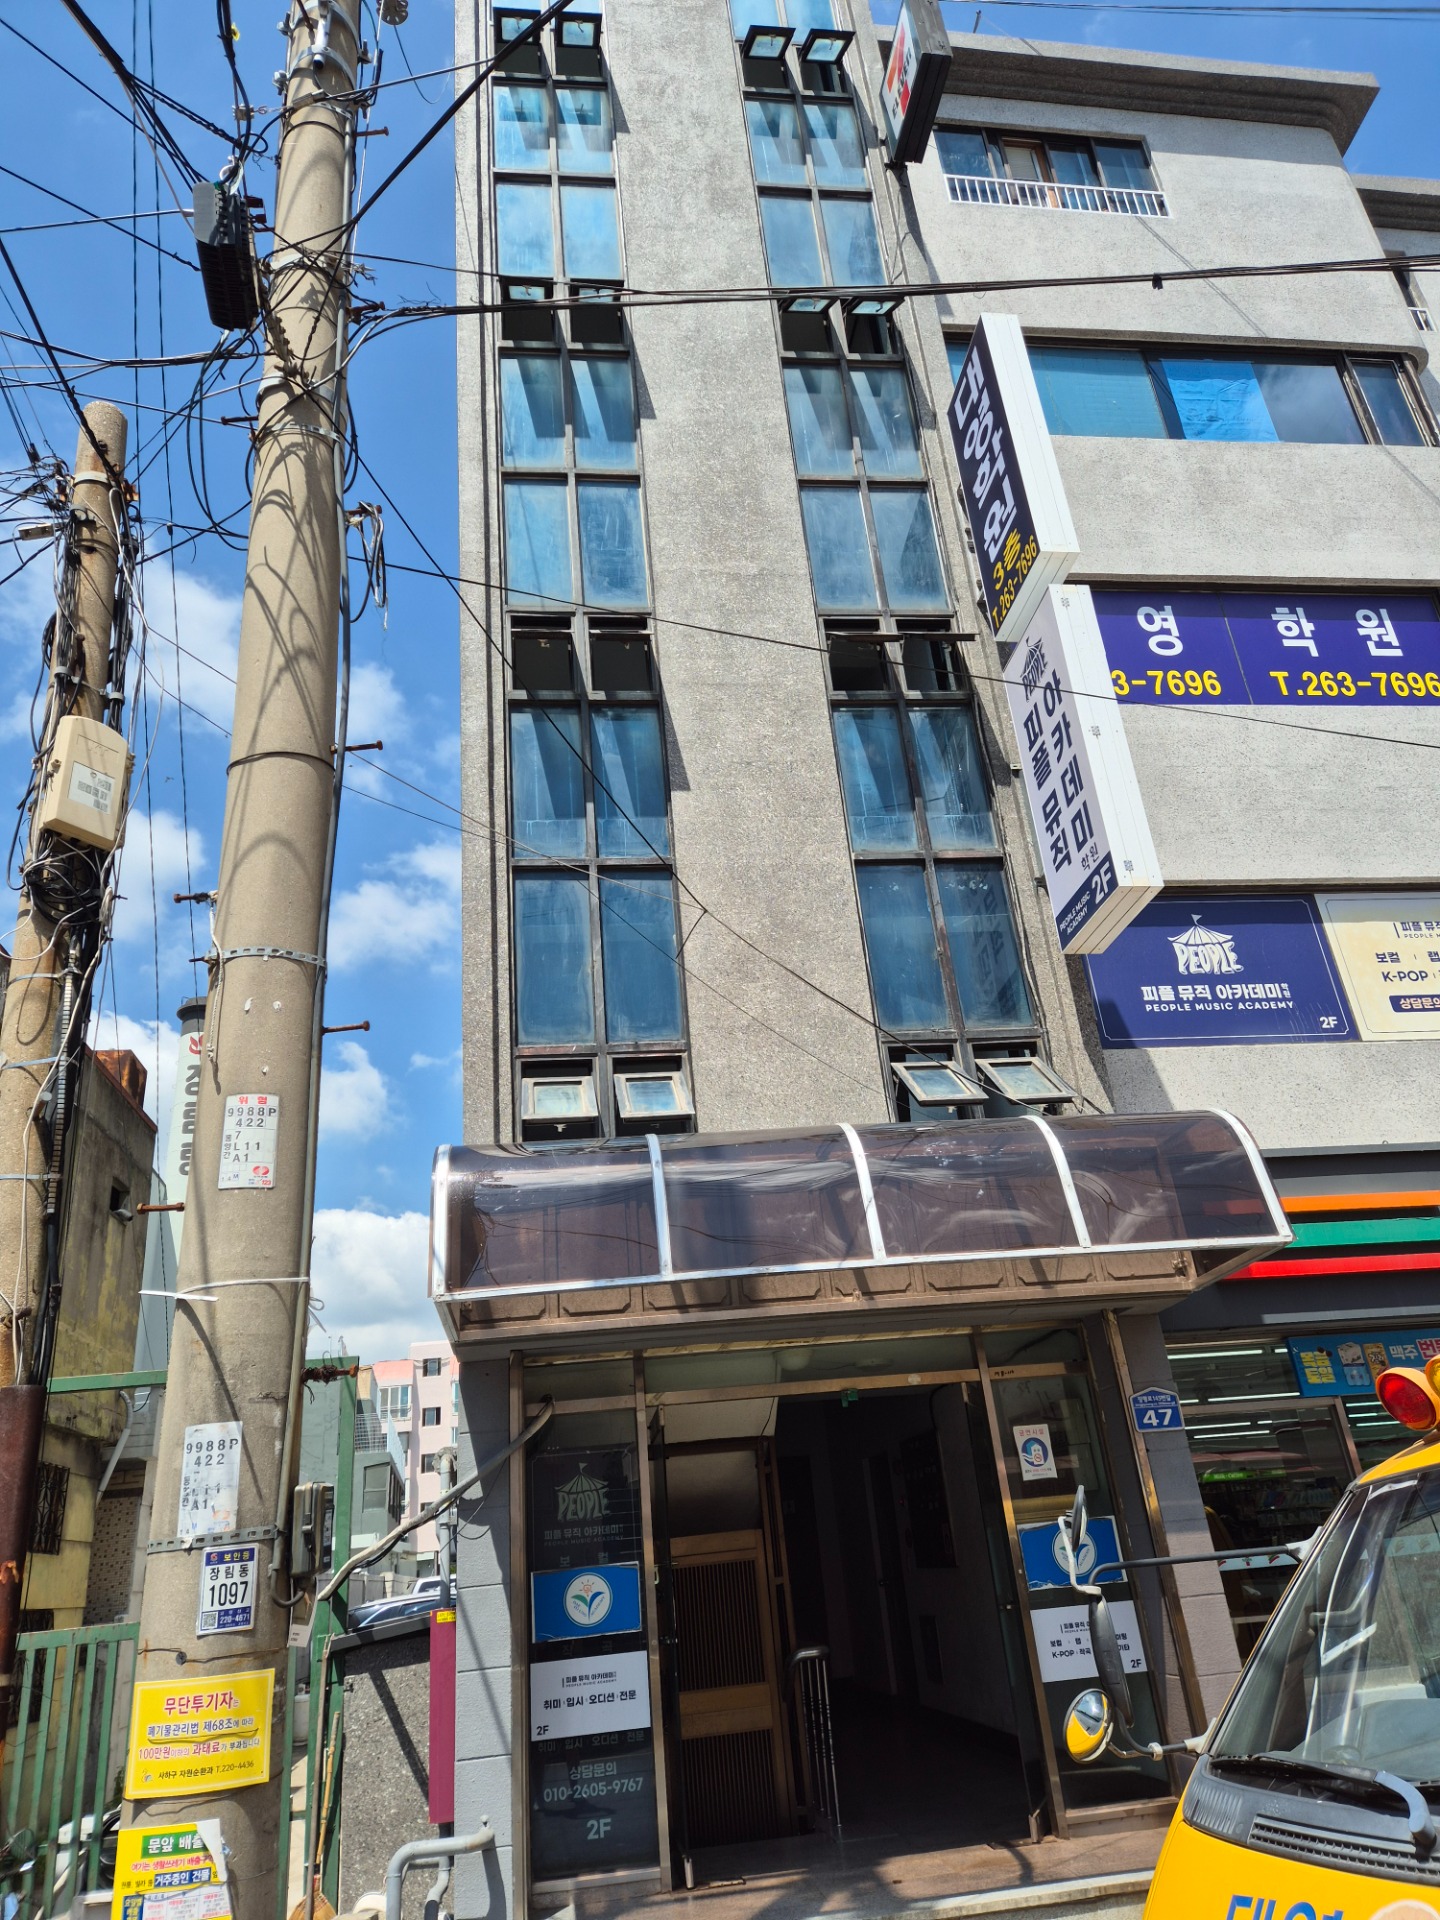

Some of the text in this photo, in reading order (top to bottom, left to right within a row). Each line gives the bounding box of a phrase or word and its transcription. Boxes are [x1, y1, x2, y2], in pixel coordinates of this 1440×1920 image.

[954, 345, 1017, 563] 대영학원
[993, 527, 1021, 590] 3층
[992, 534, 1038, 630] T.263-7696
[1021, 653, 1049, 703] PEOPLE
[1268, 670, 1440, 698] T.263-7696
[1042, 667, 1096, 855] 아카데미
[1023, 702, 1073, 874] 피플 뮤직
[1091, 860, 1112, 905] 2F
[1400, 921, 1423, 932] 피플
[1172, 941, 1245, 975] PEOPLE
[1375, 951, 1402, 964] 보컬
[1381, 970, 1429, 982] K-POP
[1140, 985, 1176, 1002] 피플
[1177, 984, 1212, 1001] 뮤직
[1216, 983, 1283, 1001] 아카데미
[1145, 1000, 1294, 1013] PEOPLE MUSIC ACADEMY
[1319, 1016, 1338, 1029] 2F
[227, 1106, 277, 1117] 9988P
[235, 1117, 264, 1128] 422
[234, 1130, 242, 1140] 7
[232, 1153, 249, 1163] A1
[1388, 1343, 1419, 1360] 맥주
[1142, 1408, 1173, 1427] 47
[193, 1452, 225, 1468] 422
[557, 1487, 611, 1522] PEOPLE
[563, 1528, 582, 1538] 뮤직
[223, 1550, 251, 1562] 보안등
[209, 1563, 249, 1581] 장림동
[208, 1580, 249, 1608] 1097
[1052, 1649, 1075, 1659] K-POP
[1130, 1658, 1142, 1669] 2F
[164, 1691, 239, 1716] 무단투기자는
[543, 1689, 637, 1710] 취미 입시 오디션 전문
[147, 1721, 200, 1737] 폐기물관리법
[536, 1725, 549, 1736] 2F
[569, 1761, 617, 1781] 상담문의
[543, 1777, 644, 1803] 010-2605-9767
[586, 1817, 612, 1841] 2F
[147, 1836, 175, 1854] 문앞
[154, 1871, 190, 1887] 거주중인
[191, 1868, 211, 1884] 건물
